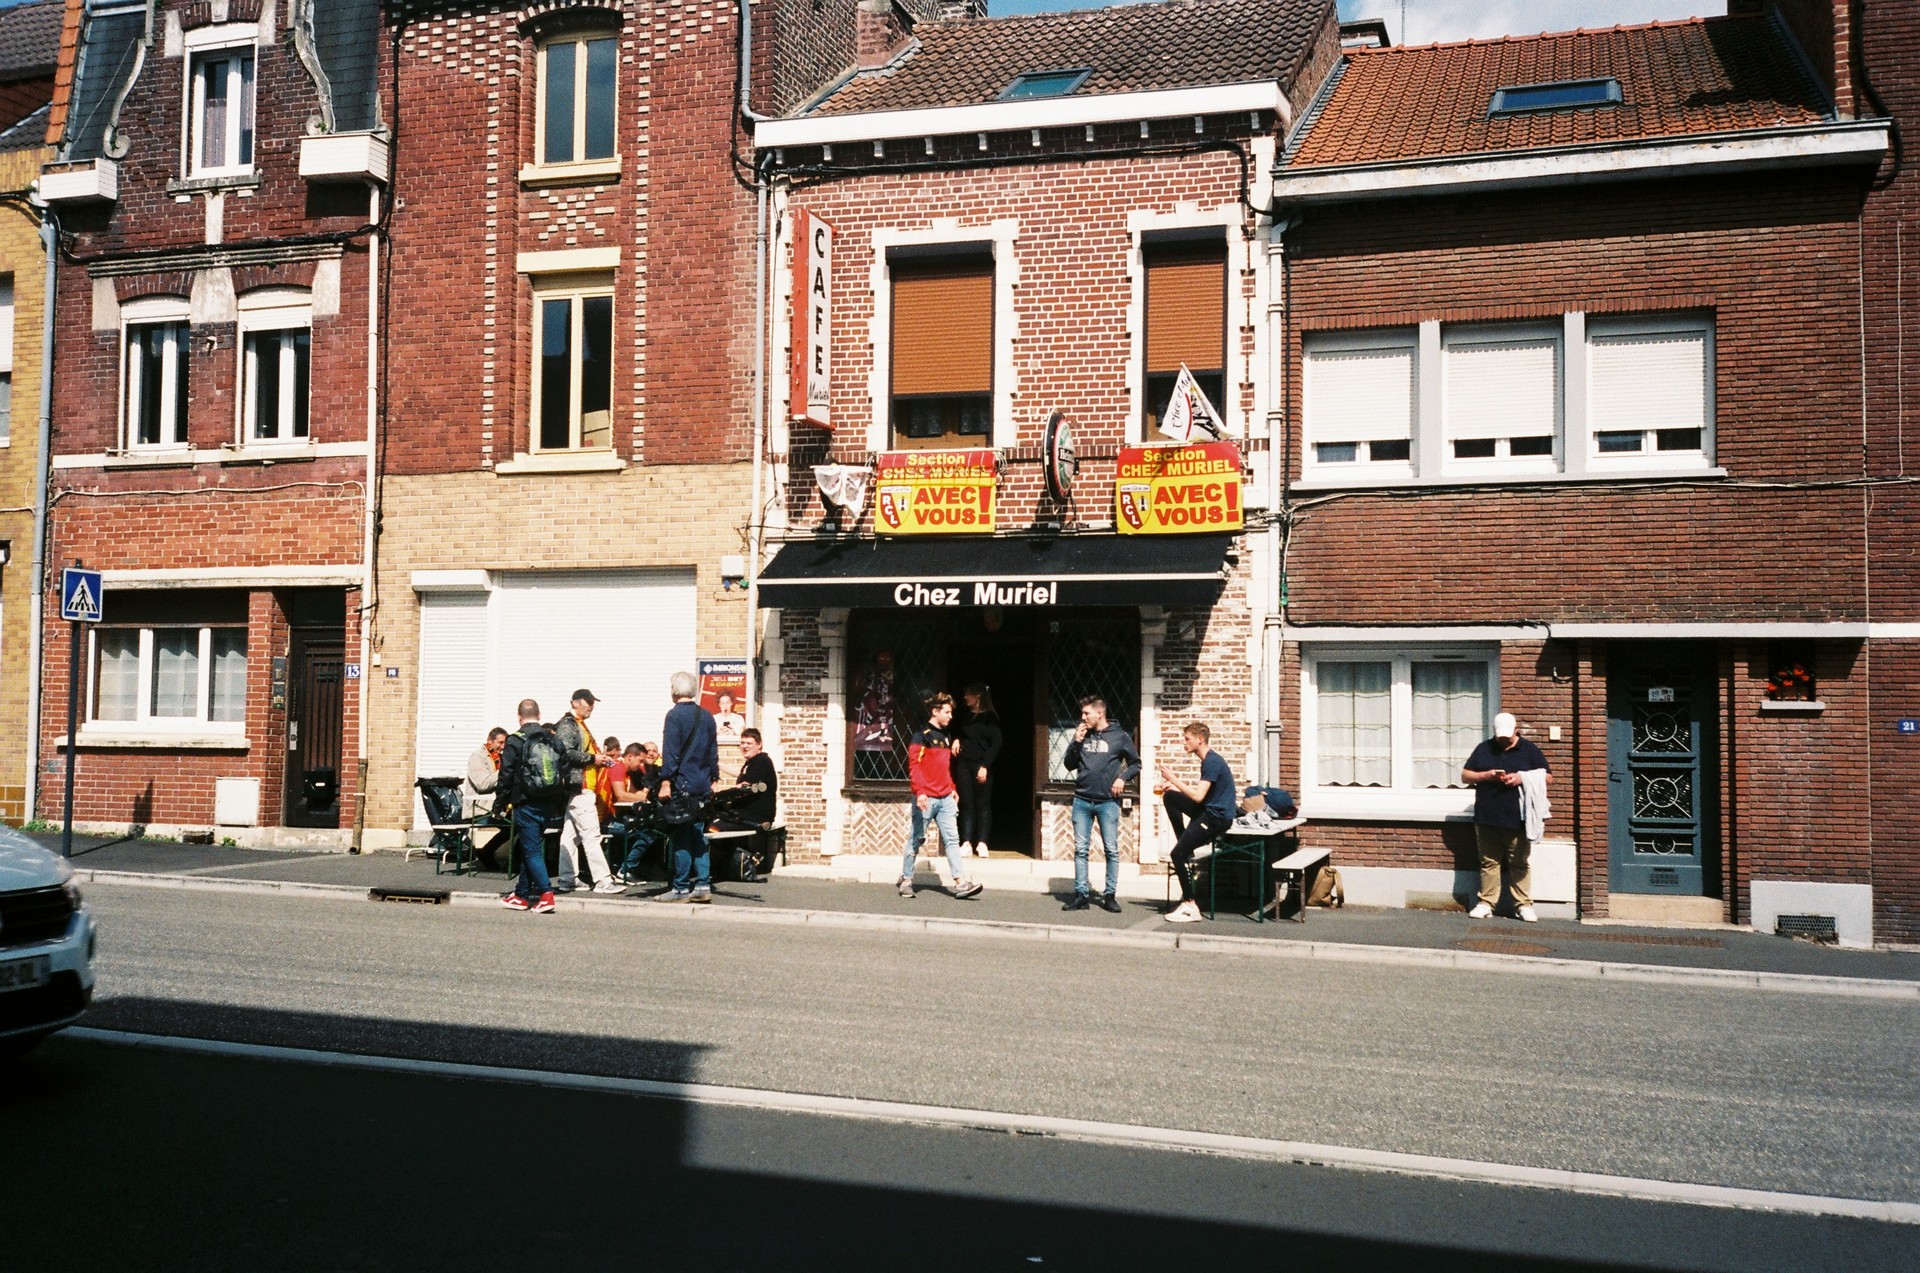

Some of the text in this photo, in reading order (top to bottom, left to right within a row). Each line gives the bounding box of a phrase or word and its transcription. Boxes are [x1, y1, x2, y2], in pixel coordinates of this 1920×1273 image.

[813, 227, 826, 376] CAFE
[907, 453, 966, 465] Section
[1143, 448, 1206, 462] Section
[882, 465, 991, 479] CHEZ MURIEL
[1121, 459, 1235, 477] CHEZ MURIEL
[914, 487, 977, 505] AVEC
[1154, 483, 1222, 505] AVEC
[914, 508, 976, 526] VOUS
[1154, 505, 1224, 526] VOUS
[894, 582, 1058, 606] Chez Muriel
[347, 665, 360, 677] 13
[1902, 721, 1915, 731] 21
